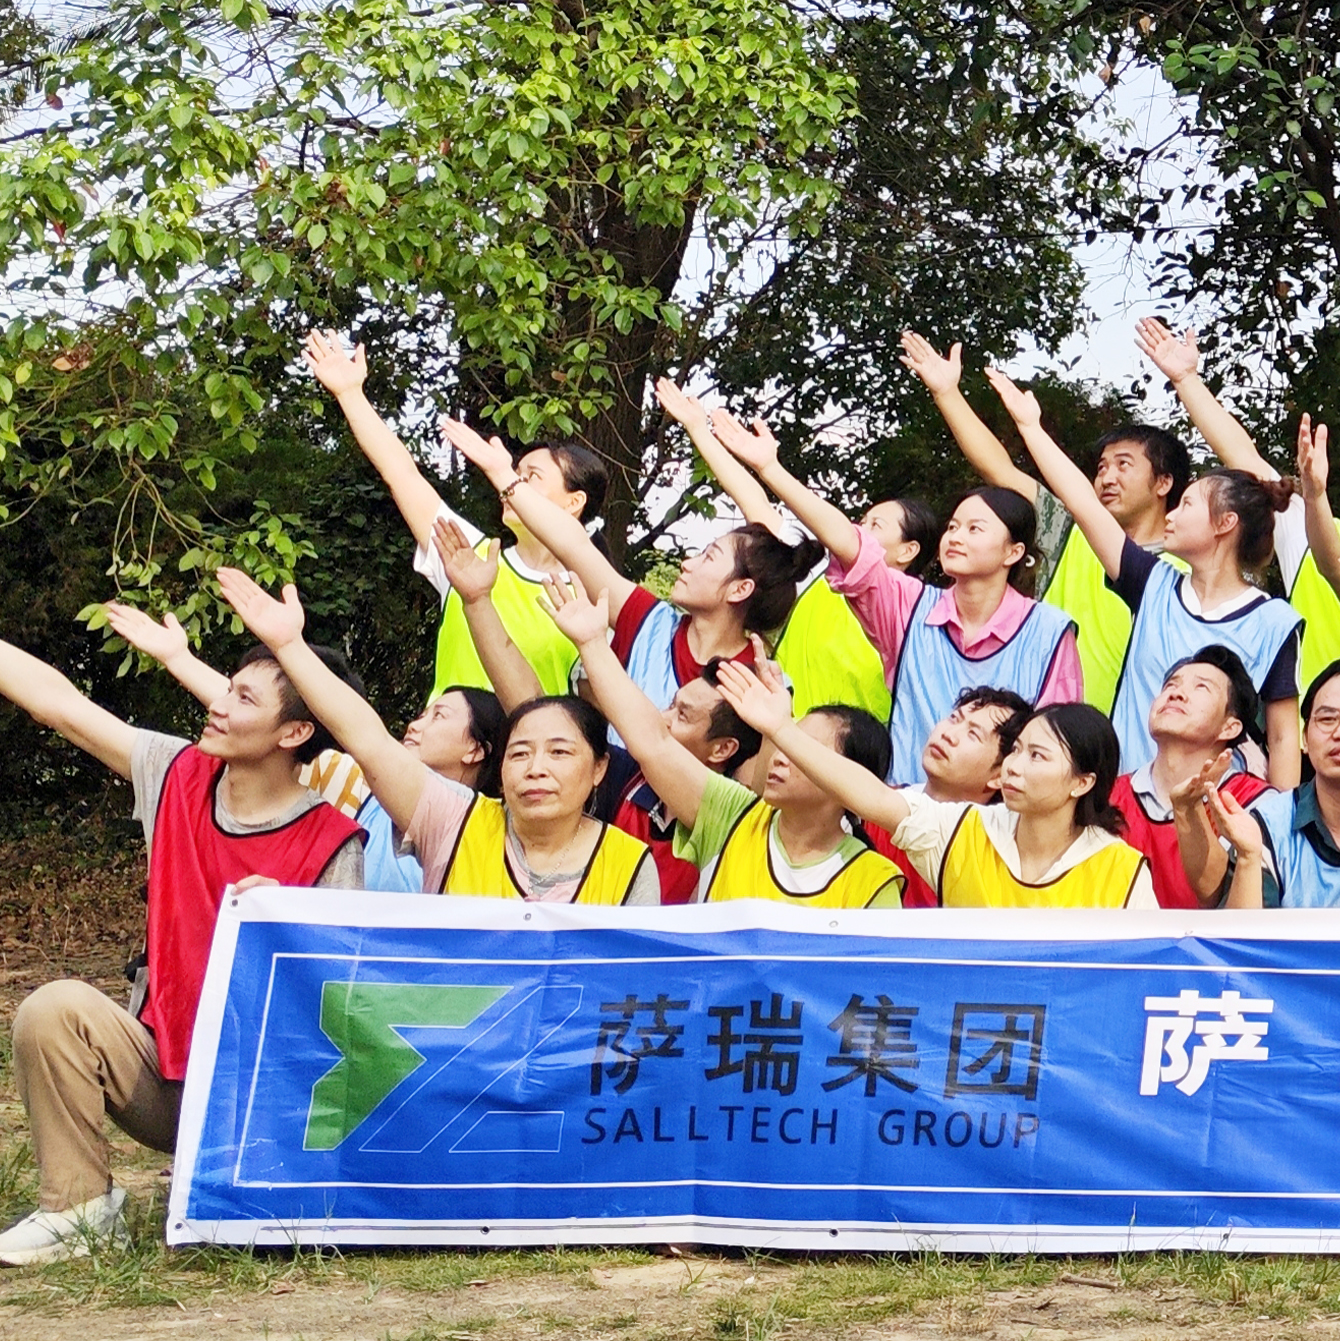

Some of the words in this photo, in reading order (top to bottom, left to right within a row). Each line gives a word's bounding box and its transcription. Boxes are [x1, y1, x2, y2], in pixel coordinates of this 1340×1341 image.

[589, 993, 1047, 1101] 萨瑞集团
[581, 1105, 839, 1145] SALLTECH
[877, 1108, 1040, 1149] GROUP
